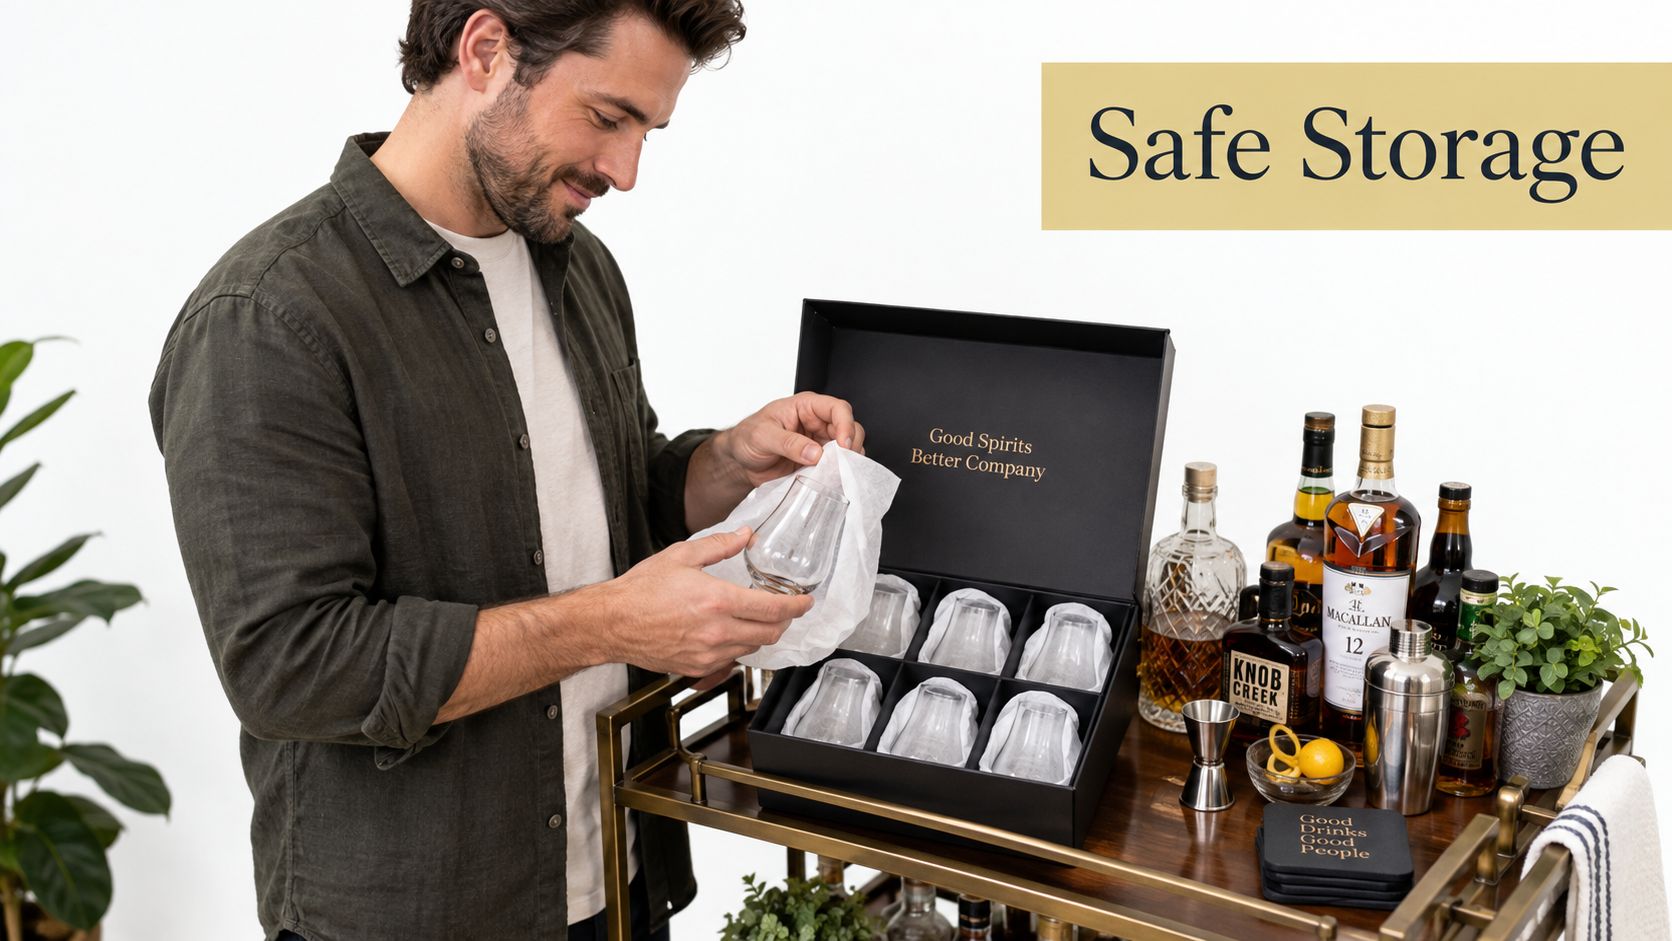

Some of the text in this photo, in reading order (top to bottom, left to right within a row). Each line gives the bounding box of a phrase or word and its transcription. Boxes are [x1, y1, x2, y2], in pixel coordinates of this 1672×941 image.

[929, 427, 1033, 455] Good Spirits
[911, 447, 1047, 483] Better Company
[1326, 605, 1392, 628] MACALLAN
[1345, 636, 1364, 655] 12
[1233, 657, 1282, 691] KNOB
[1233, 680, 1278, 707] CREEK
[1300, 814, 1353, 826] Good
[1300, 833, 1355, 847] Good
[1301, 824, 1368, 838] Drinks
[1301, 844, 1370, 860] People
